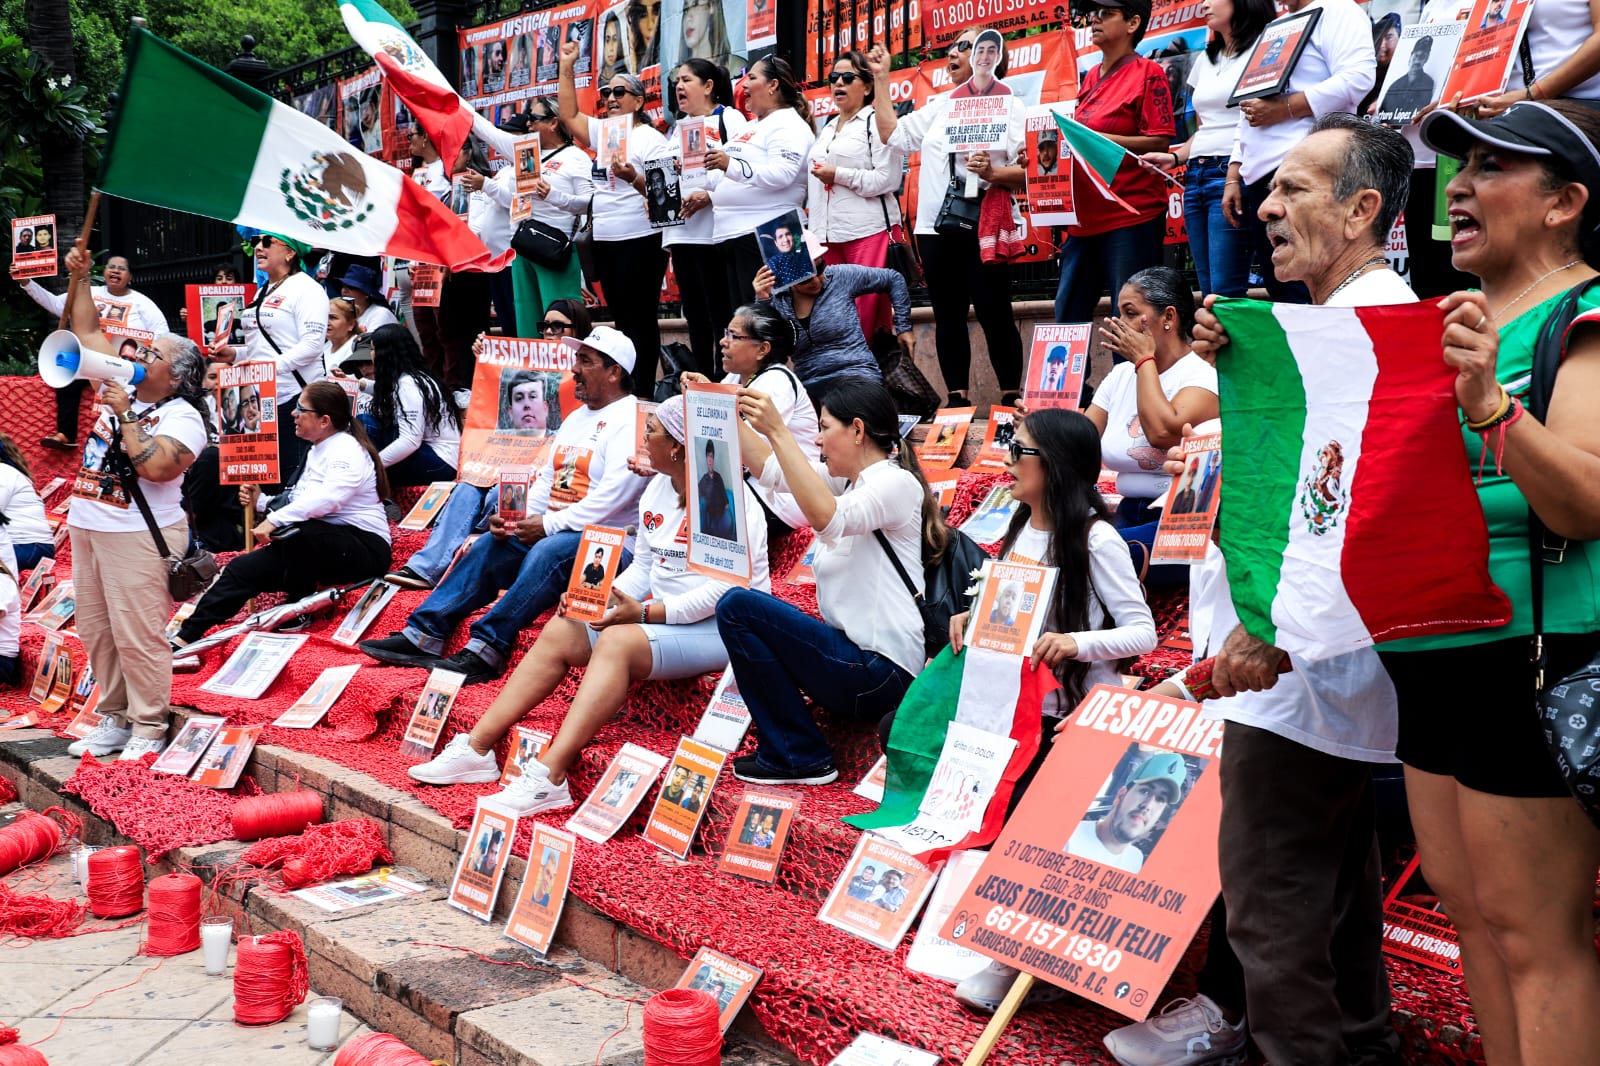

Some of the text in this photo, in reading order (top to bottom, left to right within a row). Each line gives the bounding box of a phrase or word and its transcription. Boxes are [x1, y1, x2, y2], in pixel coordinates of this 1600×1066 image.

[501, 11, 551, 38] JUSTICIA
[949, 1, 974, 25] 800
[954, 97, 1004, 112] DESAPARECIDO
[1377, 111, 1393, 121] rturo
[958, 124, 980, 135] ALBERTO
[199, 285, 245, 295] LOCALIZADO
[106, 325, 154, 340] DESAPARECIDO
[1036, 326, 1087, 342] DESAPARECIDO
[219, 362, 274, 387] DESAPARECIDO
[584, 529, 623, 547] DESAPARECIDO
[992, 565, 1042, 584] DESAPARECIDO
[745, 794, 793, 810] DESAPARECIDO
[1003, 839, 1187, 914] 31 OCTUBRE 2024 CULIACÁN SIN.
[1039, 873, 1113, 910] EDAD: 28 AÑOS
[974, 874, 1173, 964] JESUS TOMAS FELIX FELIX
[985, 905, 1123, 973] 667 157 1930
[1389, 926, 1414, 944] 800
[1410, 933, 1460, 960] 6703600
[700, 951, 754, 984] DESAPARECIDO
[971, 926, 1108, 996] SABUESOS GUERRERAS, A.C.
